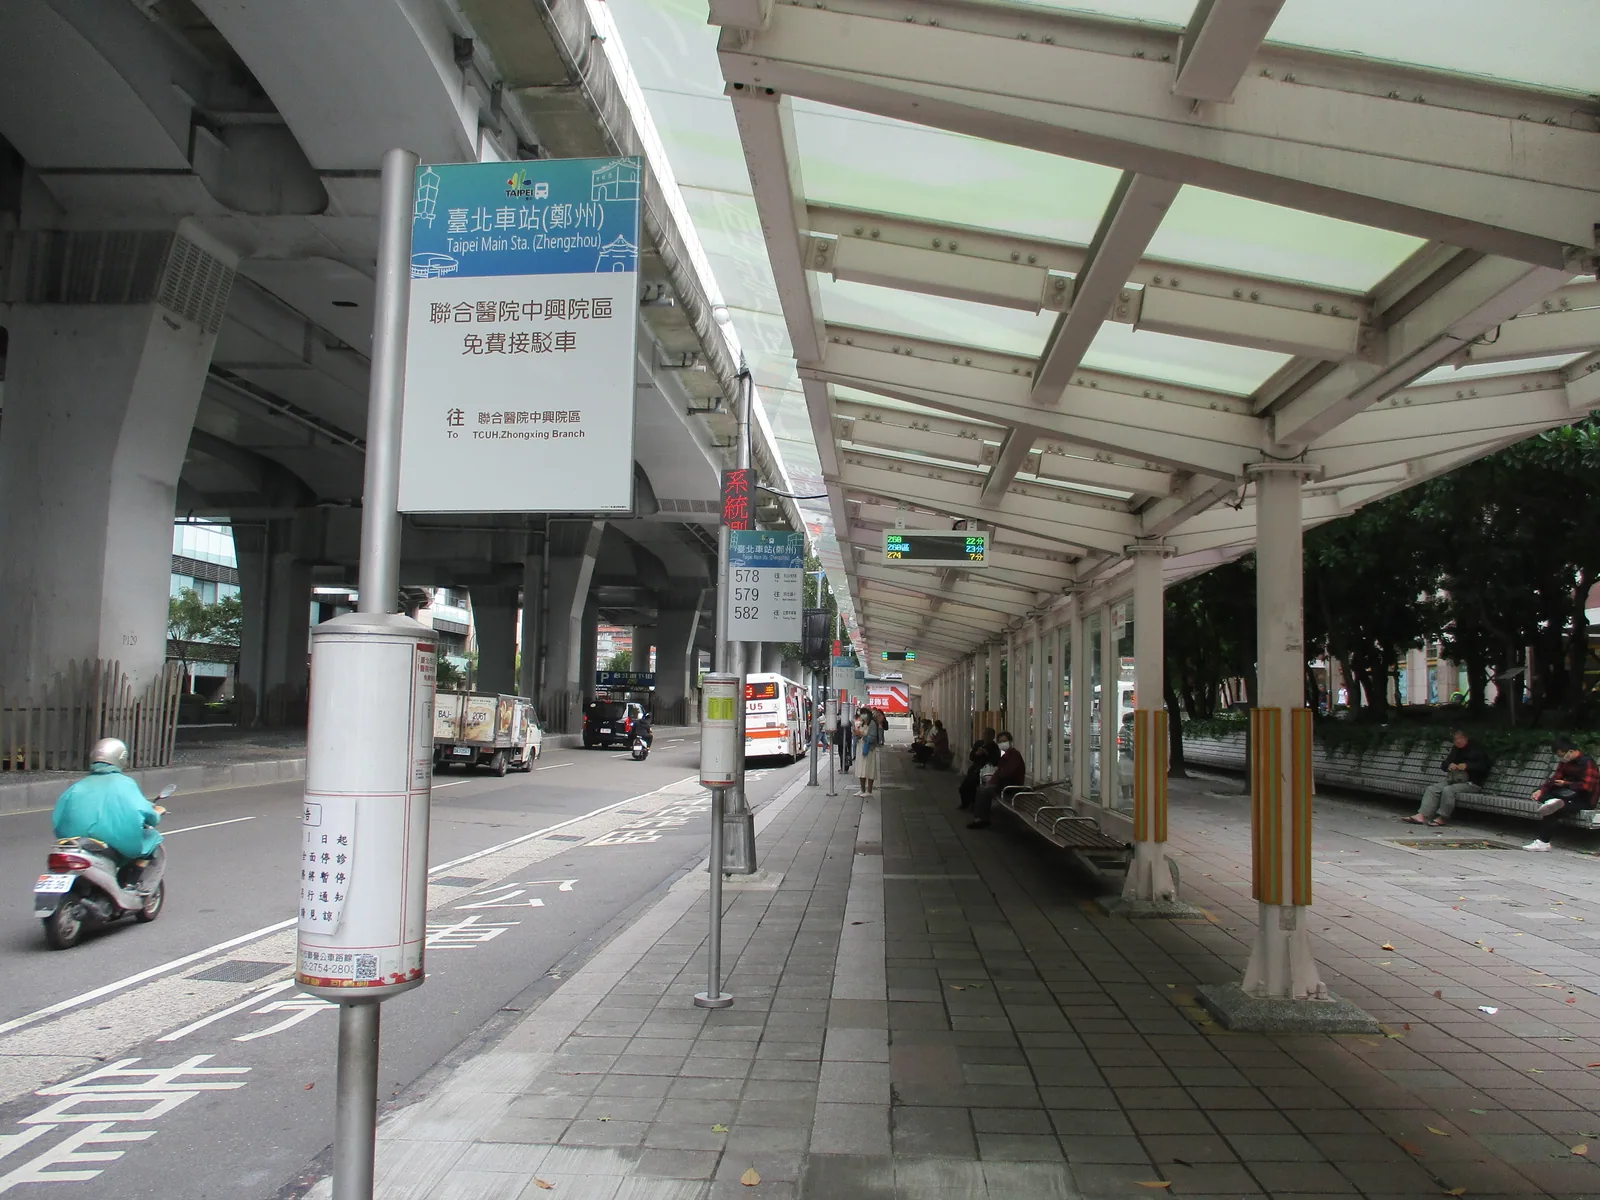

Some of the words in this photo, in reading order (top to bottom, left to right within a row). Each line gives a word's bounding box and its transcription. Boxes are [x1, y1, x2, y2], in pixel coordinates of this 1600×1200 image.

[505, 189, 533, 198] TAIPEI
[447, 203, 605, 234] 臺北車站(鄭州)
[447, 237, 479, 256] Taipei
[481, 236, 508, 251] Main
[510, 235, 531, 251] Sta.
[533, 232, 602, 252] (Zhengzhou)
[429, 297, 613, 325] 聯合醫院中興院區
[461, 330, 577, 356] 免費接駁車
[446, 408, 465, 427] 往
[478, 410, 581, 425] 聯合醫院中興院區
[447, 430, 459, 439] To
[552, 429, 585, 438] Branch
[965, 537, 985, 545] 22分
[965, 545, 985, 553] 23分
[969, 553, 984, 561] 7分
[735, 569, 760, 583] 578
[735, 587, 760, 601] 579
[734, 606, 759, 620] 582
[600, 672, 610, 683] P
